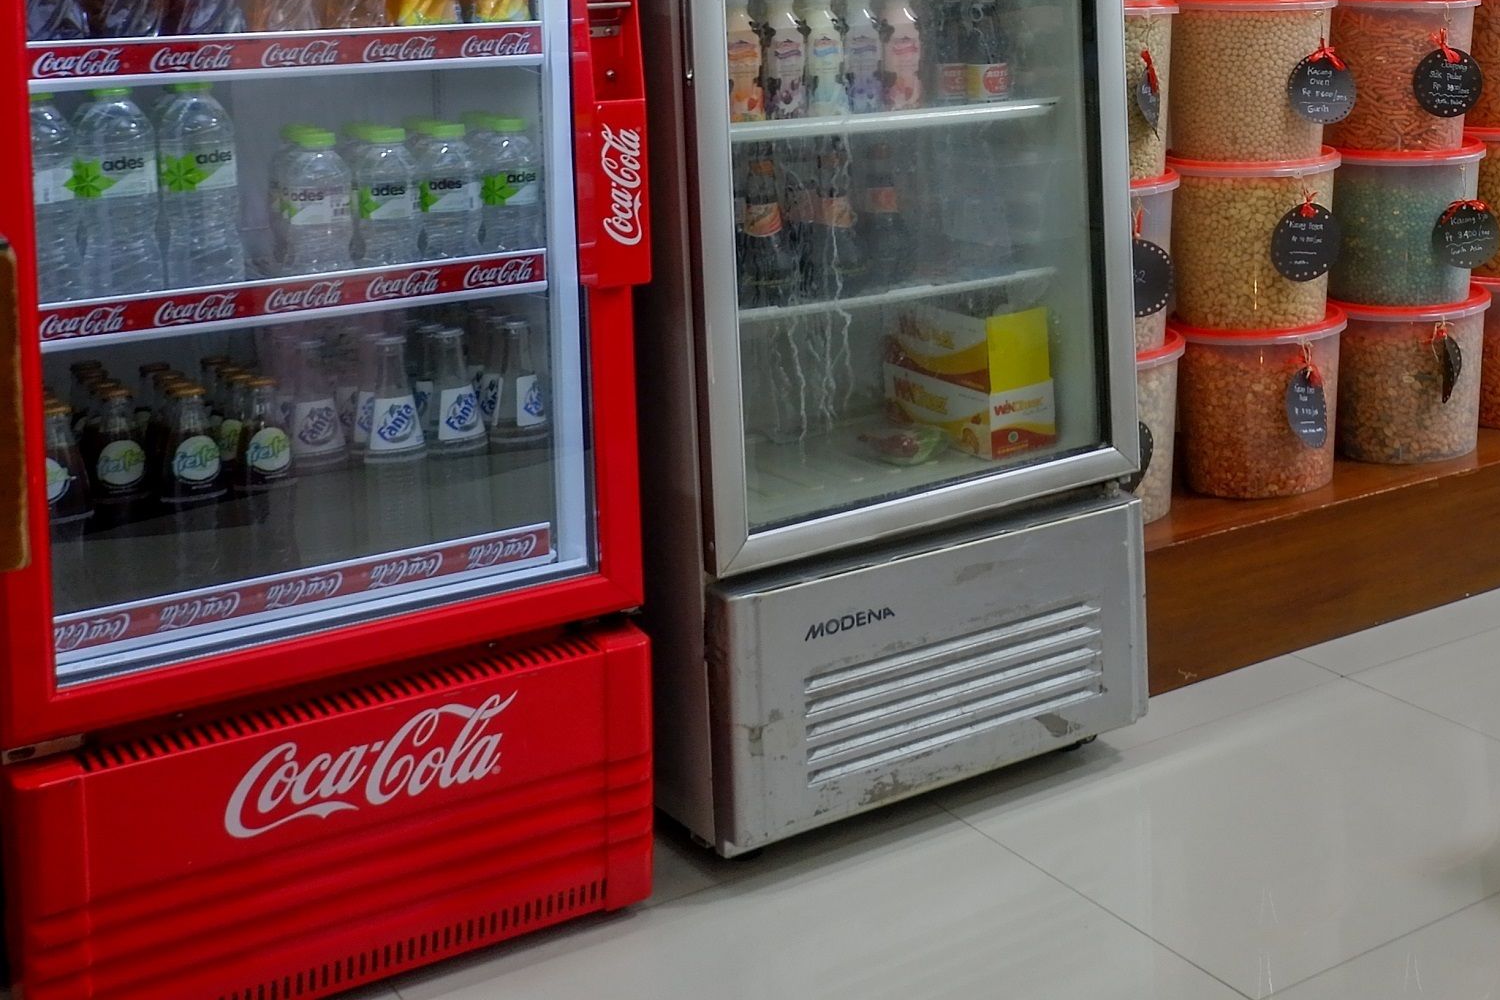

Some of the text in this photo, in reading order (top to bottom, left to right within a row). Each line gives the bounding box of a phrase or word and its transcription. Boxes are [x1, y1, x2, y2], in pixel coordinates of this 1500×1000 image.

[150, 44, 235, 72] Coca-Cola
[261, 39, 341, 67] Coca-Cola
[362, 36, 438, 62] Coca-Cola
[461, 32, 533, 57] Coca-Cola
[32, 47, 123, 77] Coca-Cola
[1309, 78, 1330, 86] Oven
[102, 156, 144, 173] ades
[196, 149, 232, 165] ades
[372, 184, 406, 197] ades
[429, 177, 463, 190] ades
[506, 170, 537, 184] ades
[601, 123, 642, 246] Coca-Cola
[290, 189, 325, 202] ades
[366, 267, 441, 300] Coca-Cola
[463, 258, 535, 288] Coca-Cola
[154, 292, 239, 326] Coca-Cola
[264, 280, 344, 313] Coca-Cola
[40, 304, 127, 340] Coca-Cola
[446, 391, 477, 431] Fanta
[480, 389, 498, 415] Fan
[299, 406, 333, 443] Fanta
[377, 403, 413, 441] Fanta
[467, 533, 537, 569] Coca-Cola
[368, 552, 443, 590] Coca-Cola
[263, 571, 343, 610] Coca-Cola
[160, 592, 241, 631] Coca-Cola
[804, 605, 895, 642] MODENA
[224, 689, 518, 839] Coca-Cola
